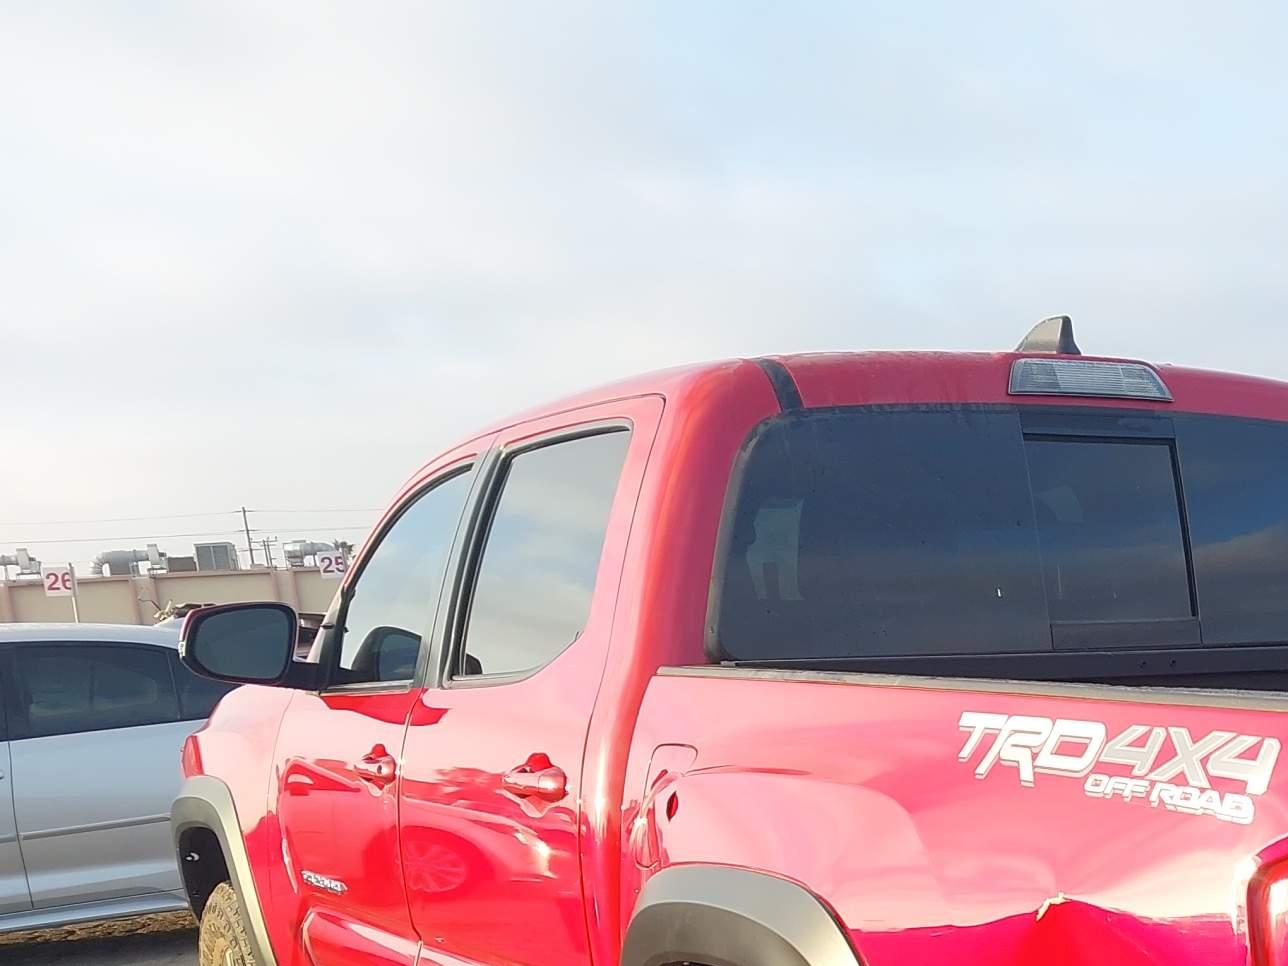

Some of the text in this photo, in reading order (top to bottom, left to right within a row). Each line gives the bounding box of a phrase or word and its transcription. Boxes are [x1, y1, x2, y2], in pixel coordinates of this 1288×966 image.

[46, 572, 73, 592] 26
[322, 555, 346, 574] 25
[957, 711, 1108, 788] TRD
[1083, 773, 1256, 826] OFF ROAD
